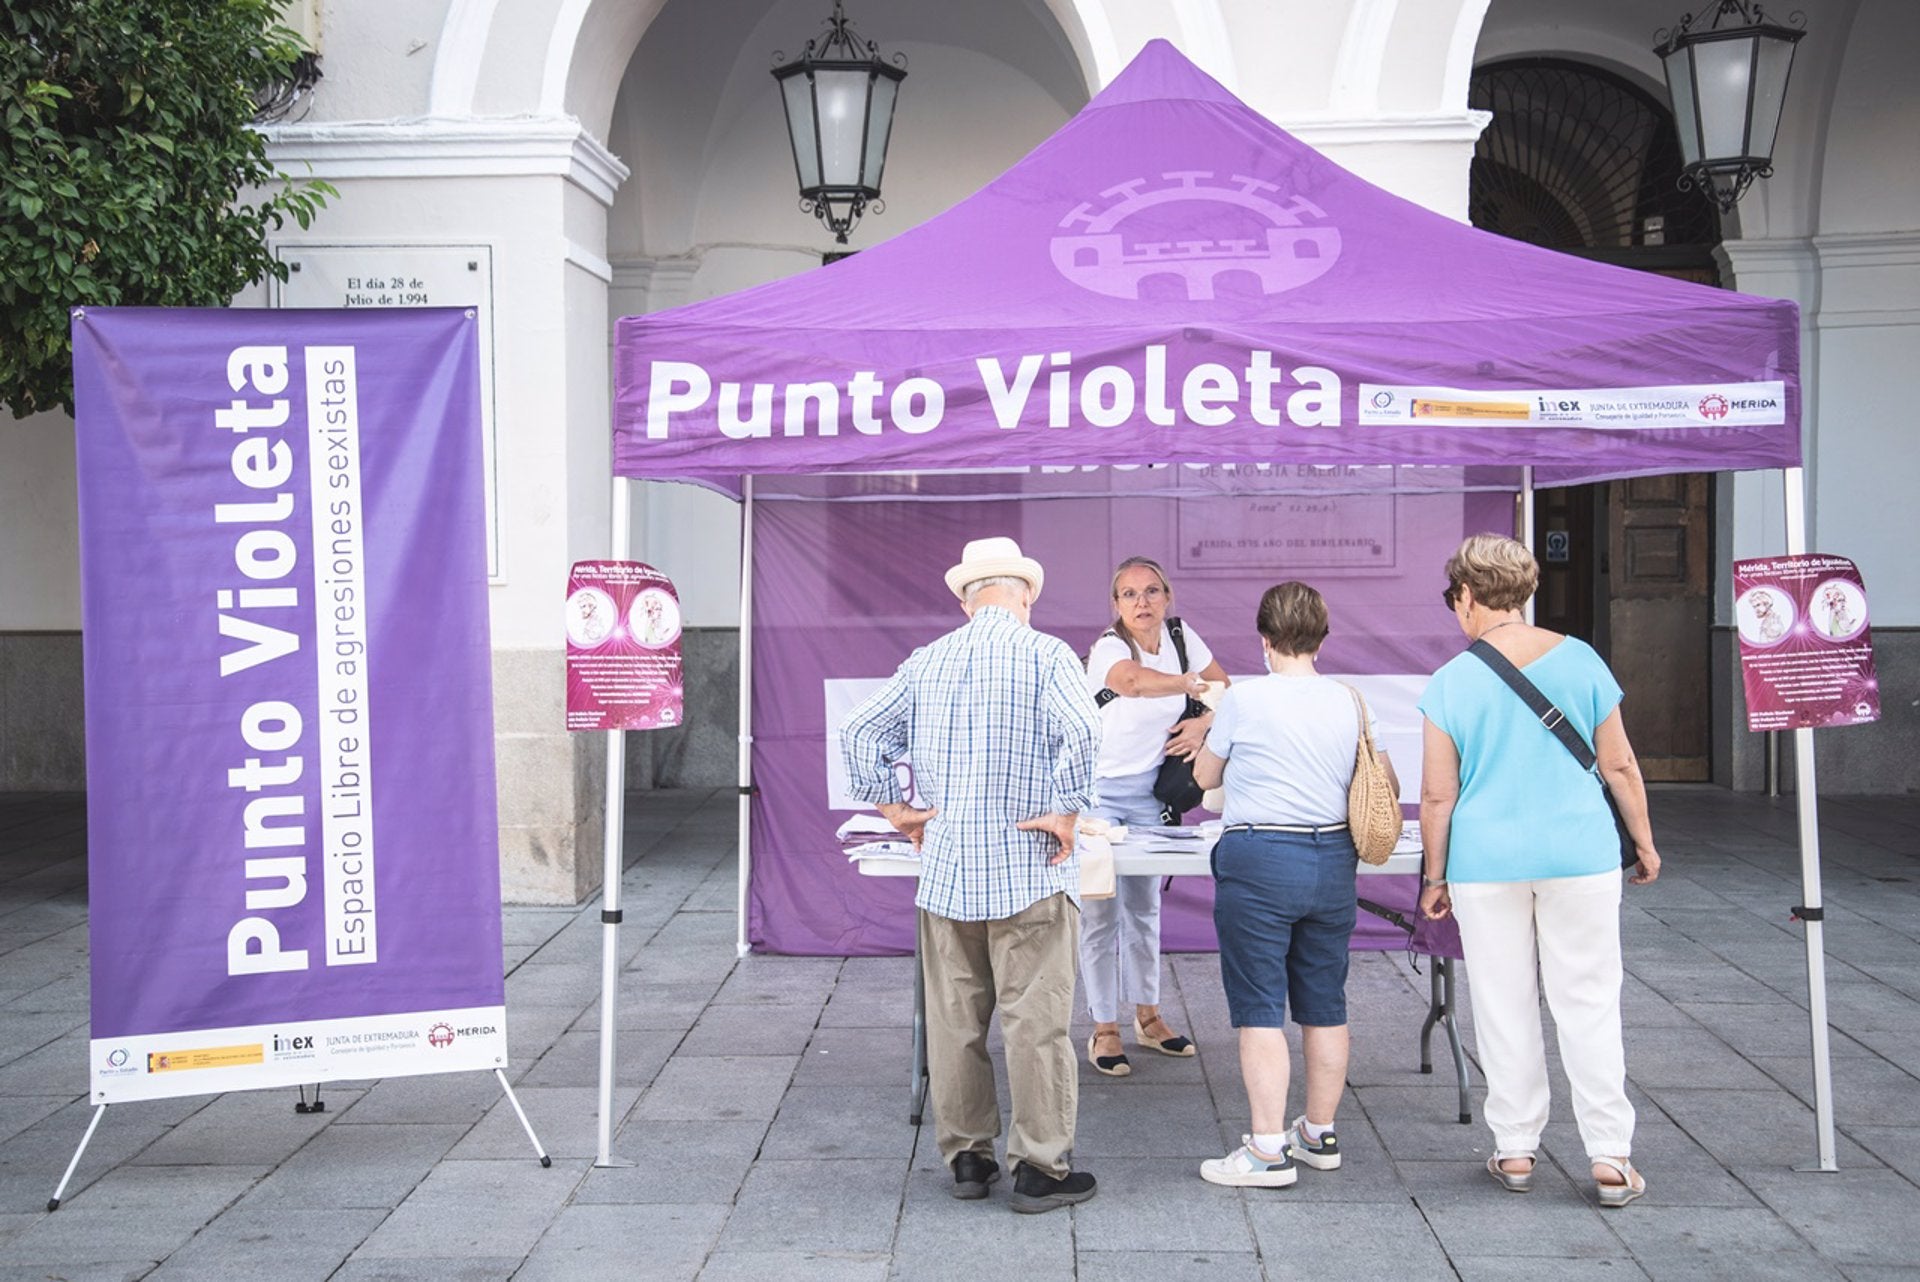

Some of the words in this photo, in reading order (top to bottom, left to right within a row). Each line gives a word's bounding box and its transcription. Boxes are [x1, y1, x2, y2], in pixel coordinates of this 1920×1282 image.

[347, 278, 361, 289] El
[390, 278, 404, 289] 28
[409, 277, 424, 289] de
[378, 294, 393, 305] de
[320, 359, 350, 489] sexistas
[646, 360, 945, 440] Punto
[976, 344, 1342, 430] Violeta
[1629, 401, 1690, 410] EXTREMADURA
[215, 345, 300, 677] Violeta
[324, 500, 364, 676] agresiones
[329, 688, 358, 724] de
[331, 736, 362, 818] Libre
[227, 700, 309, 976] Punto
[334, 831, 373, 956] Espacio
[326, 1035, 351, 1046] JUNTA
[352, 1034, 362, 1043] DE
[364, 1030, 420, 1042] EXTREMADURA
